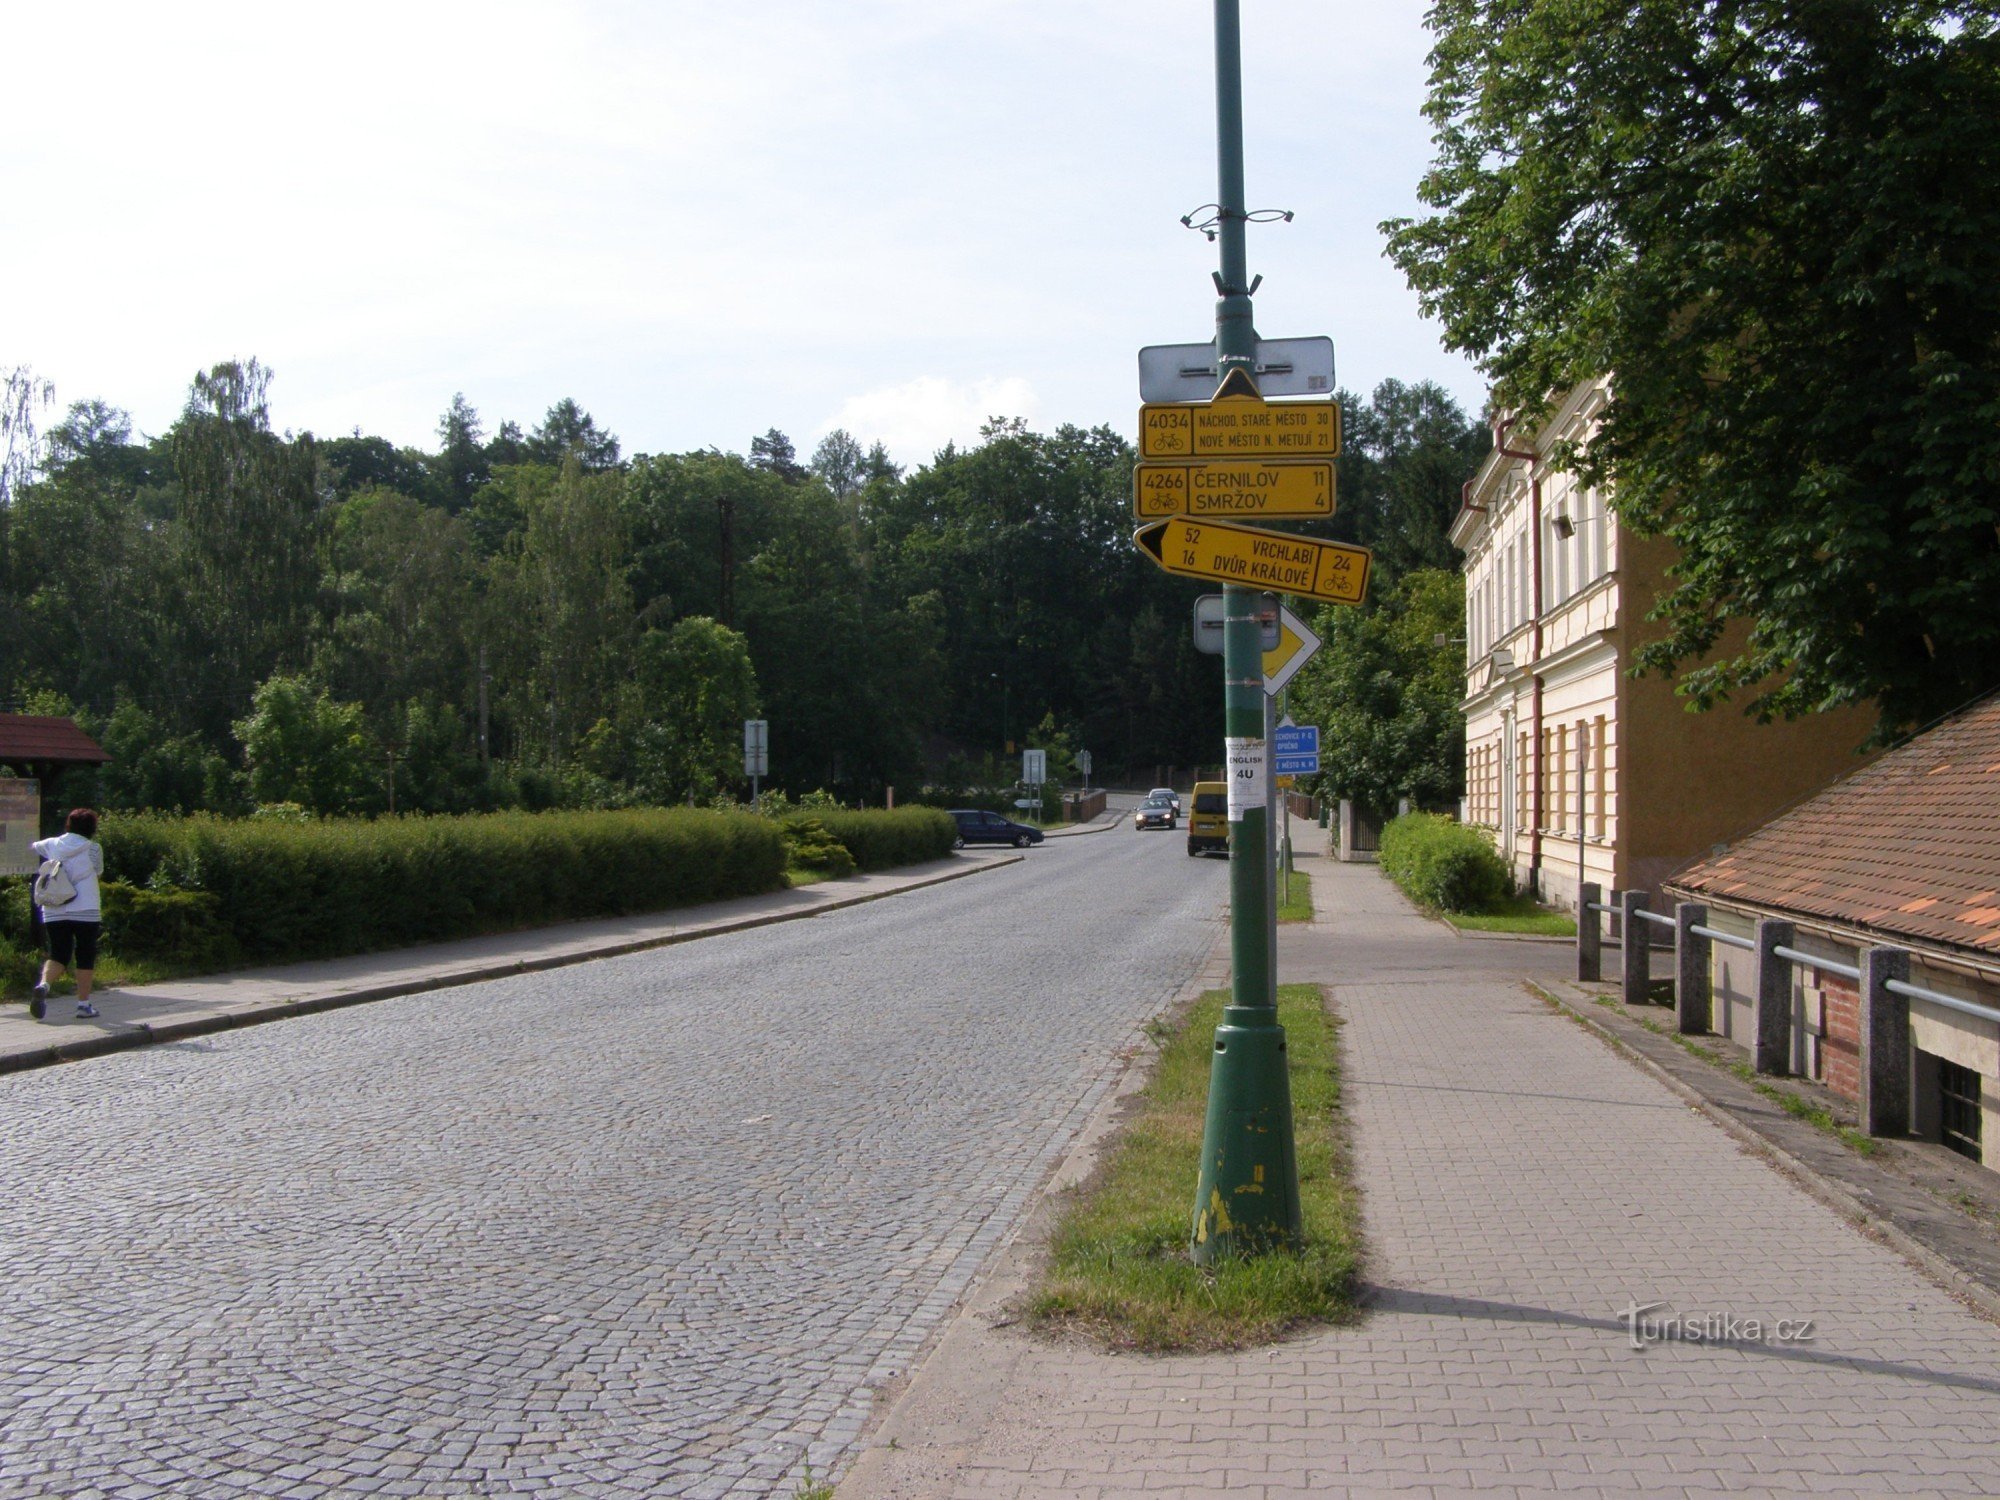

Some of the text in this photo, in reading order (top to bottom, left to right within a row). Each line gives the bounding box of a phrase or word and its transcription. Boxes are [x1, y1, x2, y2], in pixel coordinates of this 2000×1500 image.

[1148, 413, 1188, 428] 4034
[1242, 411, 1271, 427] STARÉ
[1276, 411, 1307, 426] MĚSTO
[1317, 413, 1328, 425] 30
[1199, 431, 1328, 448] NOVÉ MĚSTO N. METUJÍ 21
[1145, 473, 1183, 489] 4266
[1194, 470, 1324, 488] ČERNILOV 11
[1196, 490, 1325, 510] SMRŽOV 4
[1185, 528, 1314, 565] 52 VRCHLABÍ
[1182, 550, 1310, 587] 16 DVŮR KRÁLOVÉ
[1334, 555, 1351, 572] 24
[1229, 756, 1263, 764] ENGLISH
[1236, 769, 1254, 779] 4U
